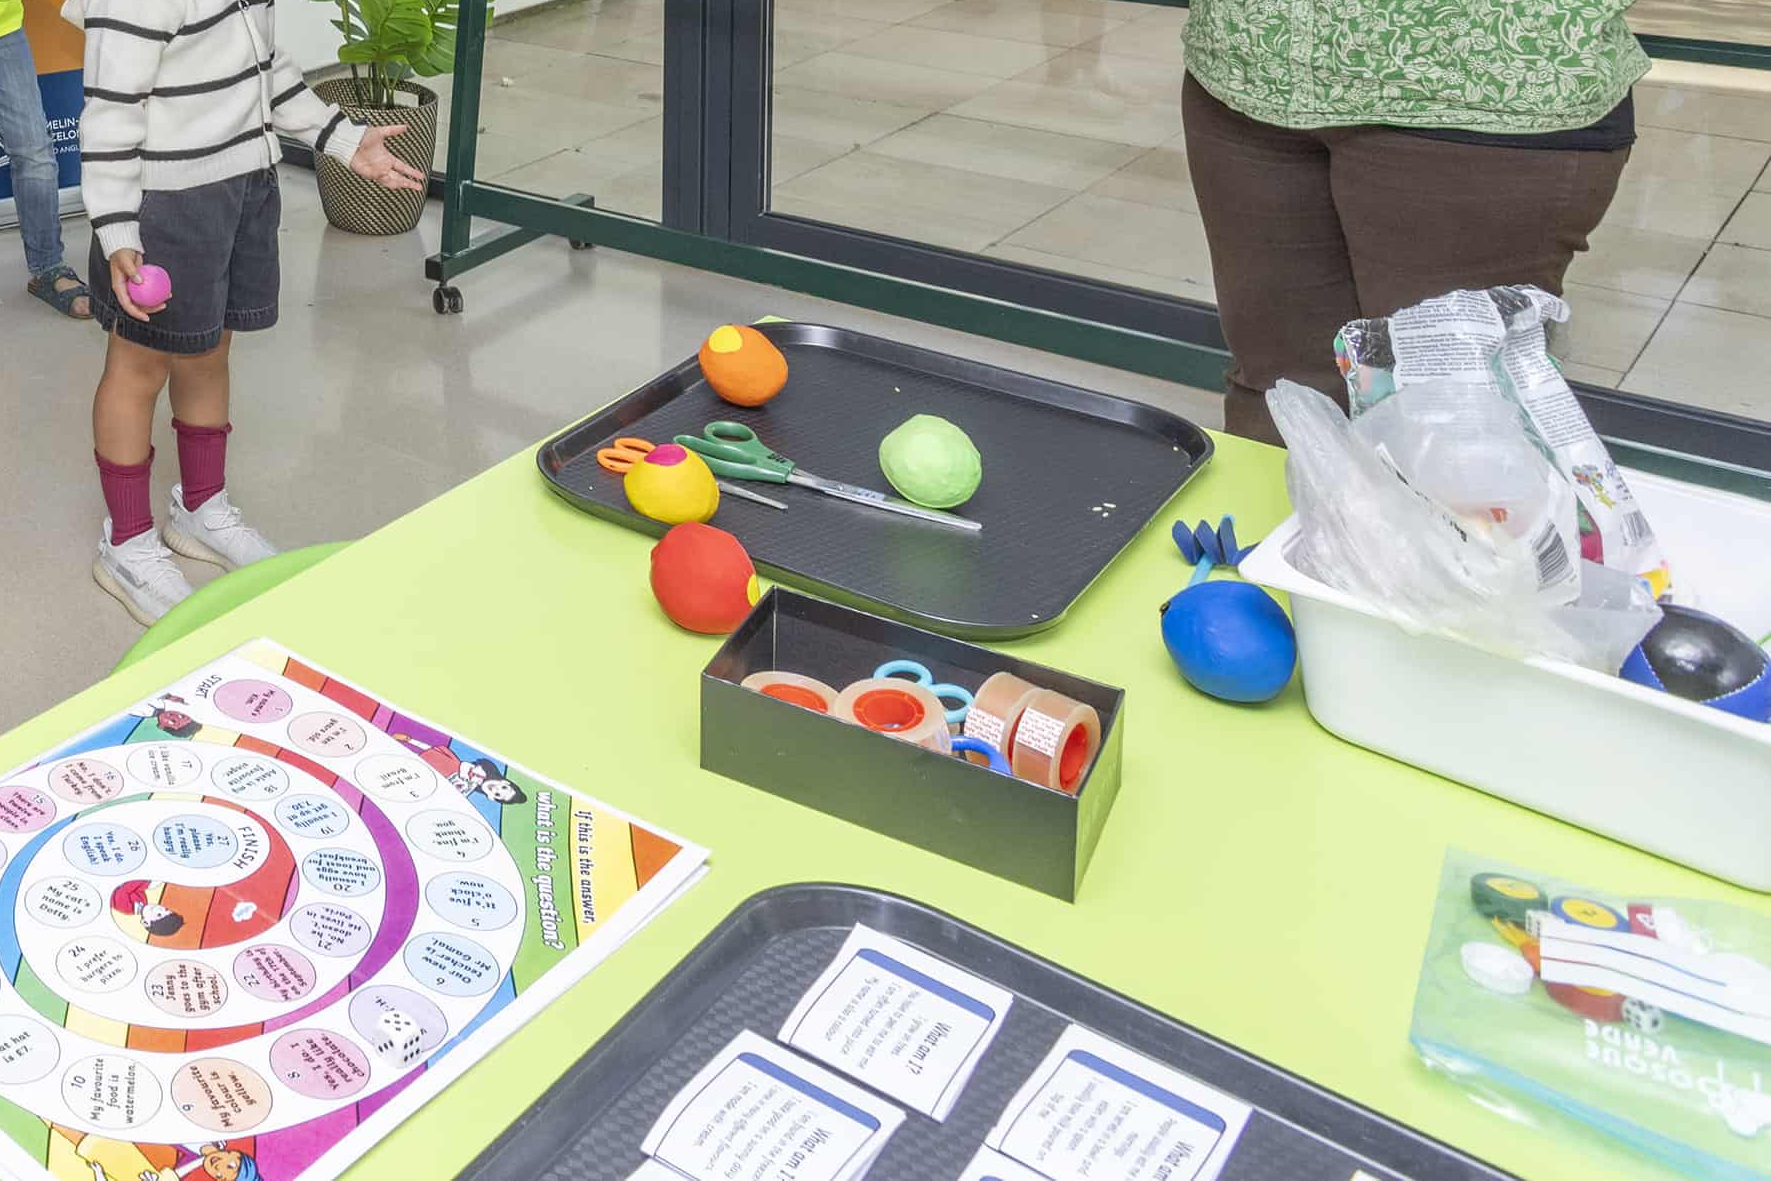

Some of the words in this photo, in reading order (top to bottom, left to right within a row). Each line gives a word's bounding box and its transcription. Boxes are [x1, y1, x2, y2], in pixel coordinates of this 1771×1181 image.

[195, 674, 223, 698] START
[535, 791, 558, 828] what
[573, 809, 593, 822] If
[535, 831, 558, 844] is
[578, 822, 594, 843] this
[233, 824, 259, 871] FINISH
[535, 846, 559, 872] the
[578, 845, 594, 856] is
[578, 857, 595, 876] the
[62, 880, 79, 891] 25
[531, 873, 566, 951] question?
[580, 878, 596, 925] answer,
[929, 1020, 953, 1046] What
[71, 1075, 86, 1089] 10
[91, 1057, 105, 1102] favourite
[106, 1083, 121, 1109] food
[89, 1102, 104, 1121] My
